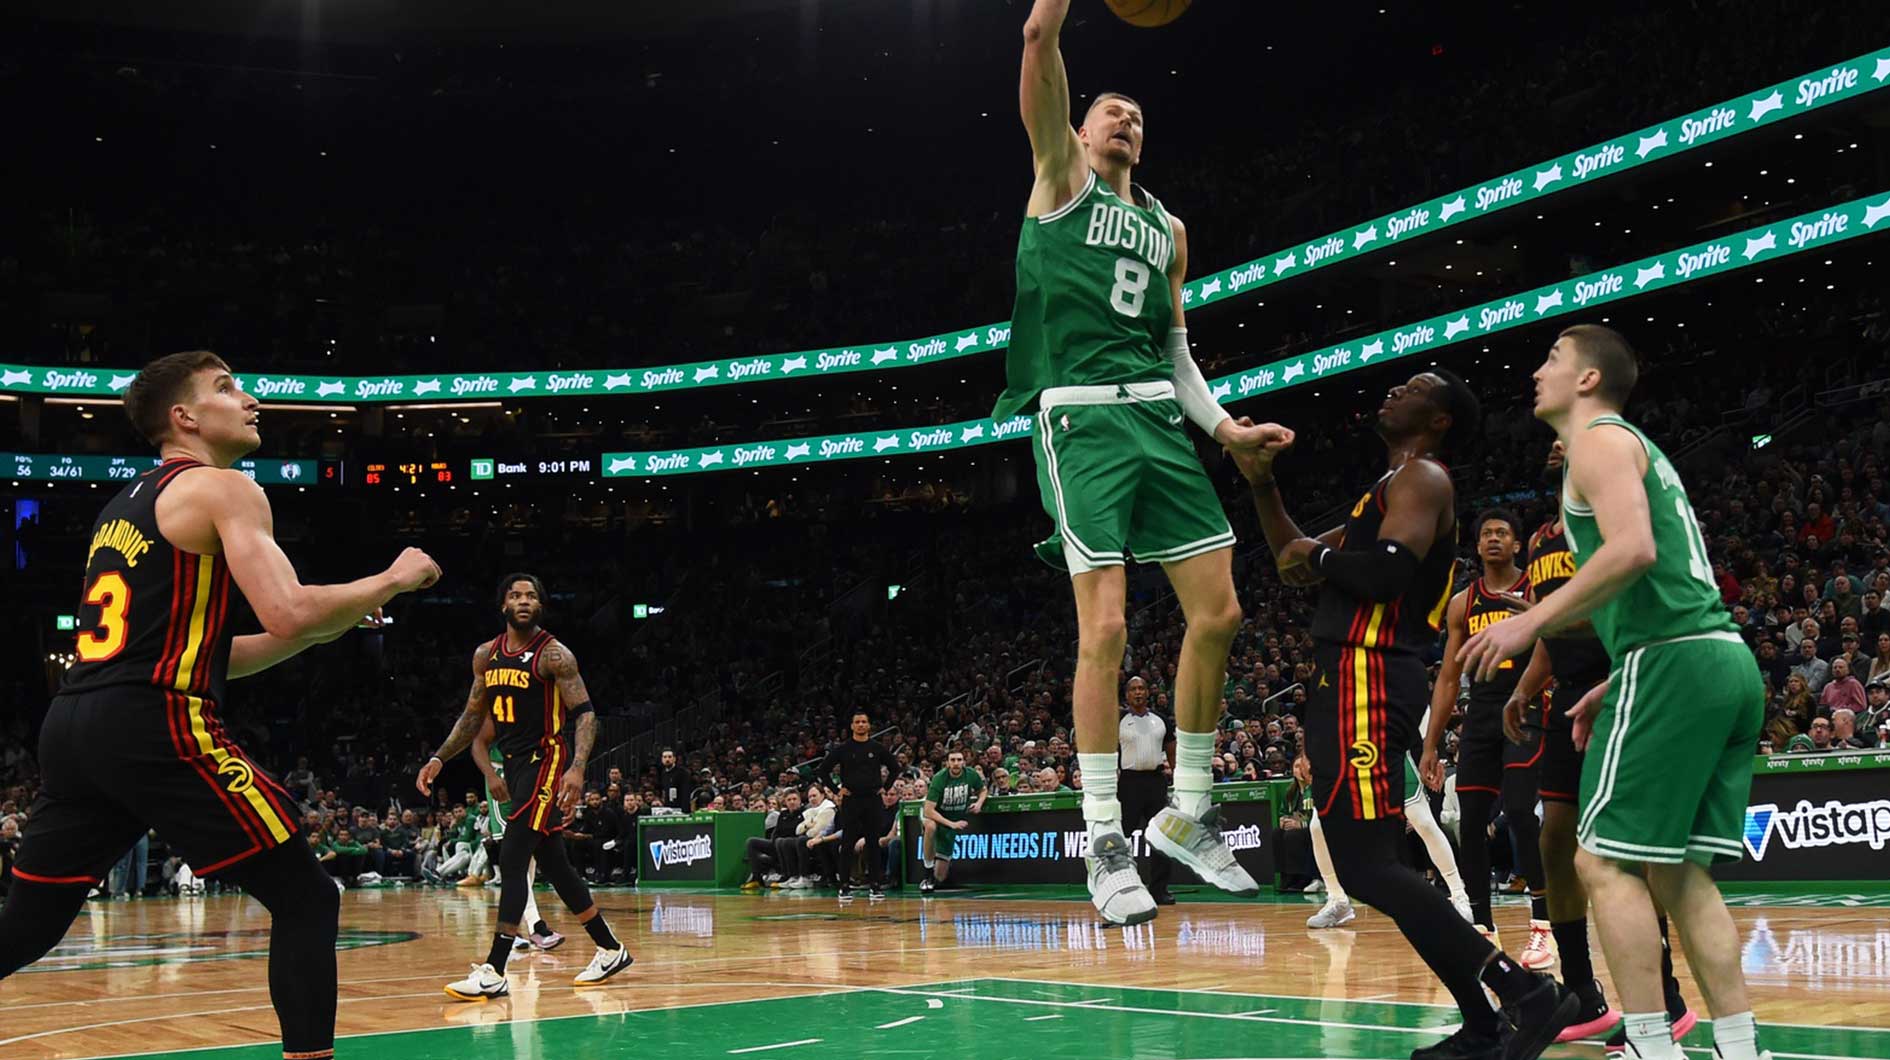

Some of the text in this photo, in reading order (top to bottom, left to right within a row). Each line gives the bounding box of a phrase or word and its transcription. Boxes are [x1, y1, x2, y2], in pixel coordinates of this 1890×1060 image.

[1228, 67, 1859, 292] Sprite Sprite Sprite Sprite Sprite Sprite Sprite
[1085, 203, 1172, 273] BOSTON
[1110, 257, 1151, 318] 8
[1238, 212, 1849, 396] Sprite Sprite Sprite Sprite Sprite Sprite Sprite
[43, 327, 1011, 399] Sprite Sprite Sprite Sprite Sprite Sprite Sprite Sprite Sprite Spr
[644, 453, 690, 474] Sprite
[731, 445, 776, 466] Sprite
[818, 437, 864, 458] Sprite
[908, 428, 953, 451] Sprite
[16, 465, 32, 476] 56
[49, 465, 82, 477] 34/61
[108, 466, 137, 478] 9/29
[472, 461, 527, 477] TD Bank
[538, 460, 590, 474] 9:01 PM
[1468, 611, 1515, 636] HAW
[485, 668, 530, 689] HAWKS
[493, 695, 515, 723] 41
[1224, 826, 1261, 851] print
[1778, 804, 1890, 845] vistap
[662, 835, 711, 865] vistaprint
[951, 834, 988, 860] STON
[991, 831, 1039, 859] NEEDS
[1042, 831, 1060, 861] IT,
